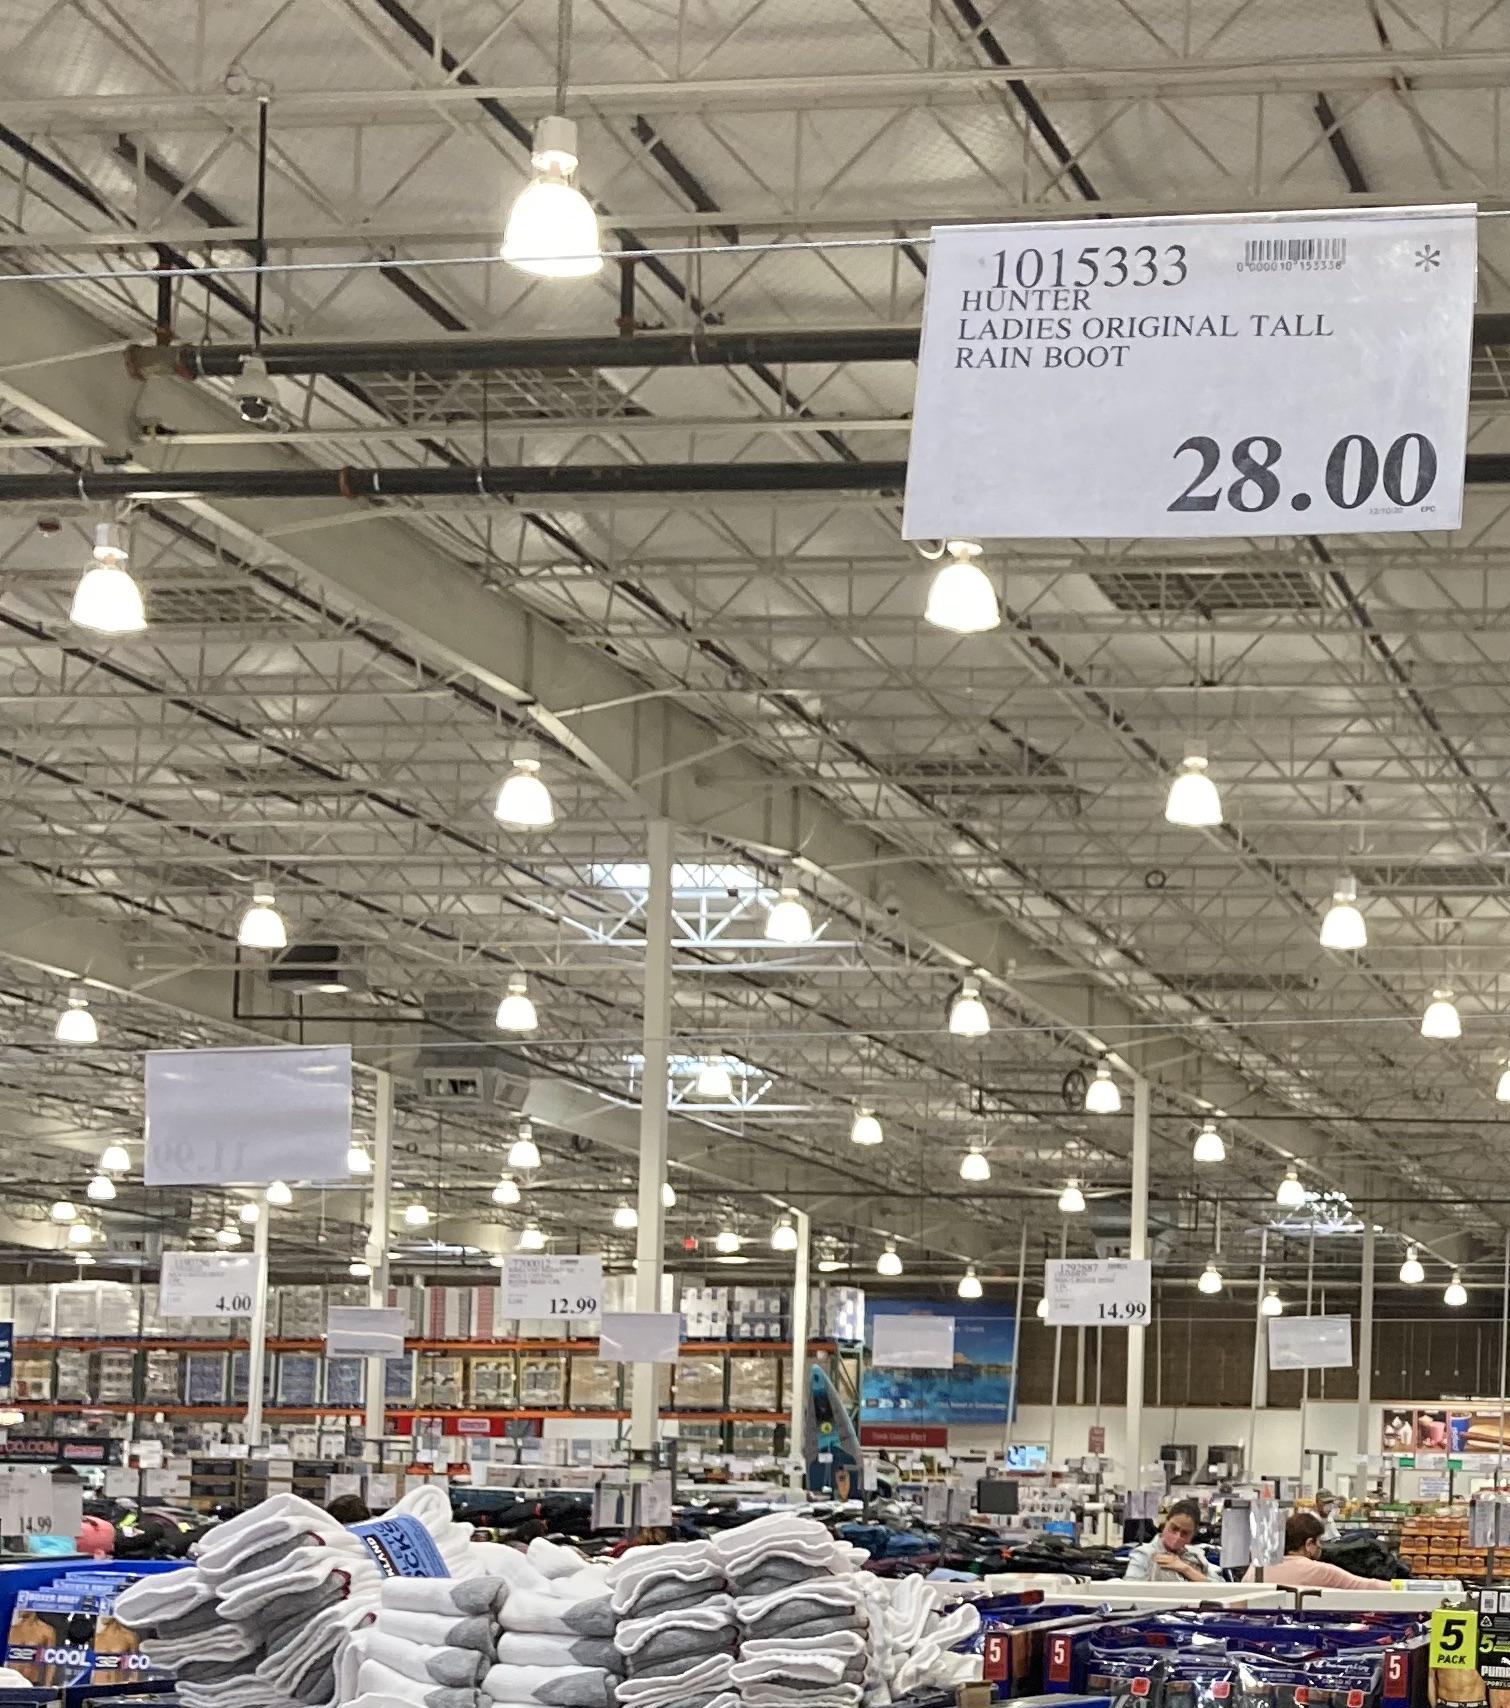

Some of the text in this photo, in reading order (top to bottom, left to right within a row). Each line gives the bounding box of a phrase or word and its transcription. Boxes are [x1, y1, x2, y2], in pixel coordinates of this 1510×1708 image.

[991, 244, 1188, 288] 1015333
[961, 288, 1092, 312] HUNTER
[957, 314, 1334, 341] LADIES ORIGINAL TALL
[954, 345, 1131, 369] RAIN BOOT
[1166, 432, 1437, 512] 28.00
[216, 1295, 251, 1311] 4.00
[550, 1297, 597, 1314] 12.99
[1099, 1302, 1146, 1319] 14.99
[1439, 1619, 1467, 1651] 5
[1479, 1633, 1496, 1653] 5
[44, 1649, 91, 1666] COOL
[990, 1638, 1001, 1661] 5
[1054, 1638, 1065, 1664] 5
[1437, 1654, 1466, 1665] PACK
[1389, 1655, 1401, 1680] 5
